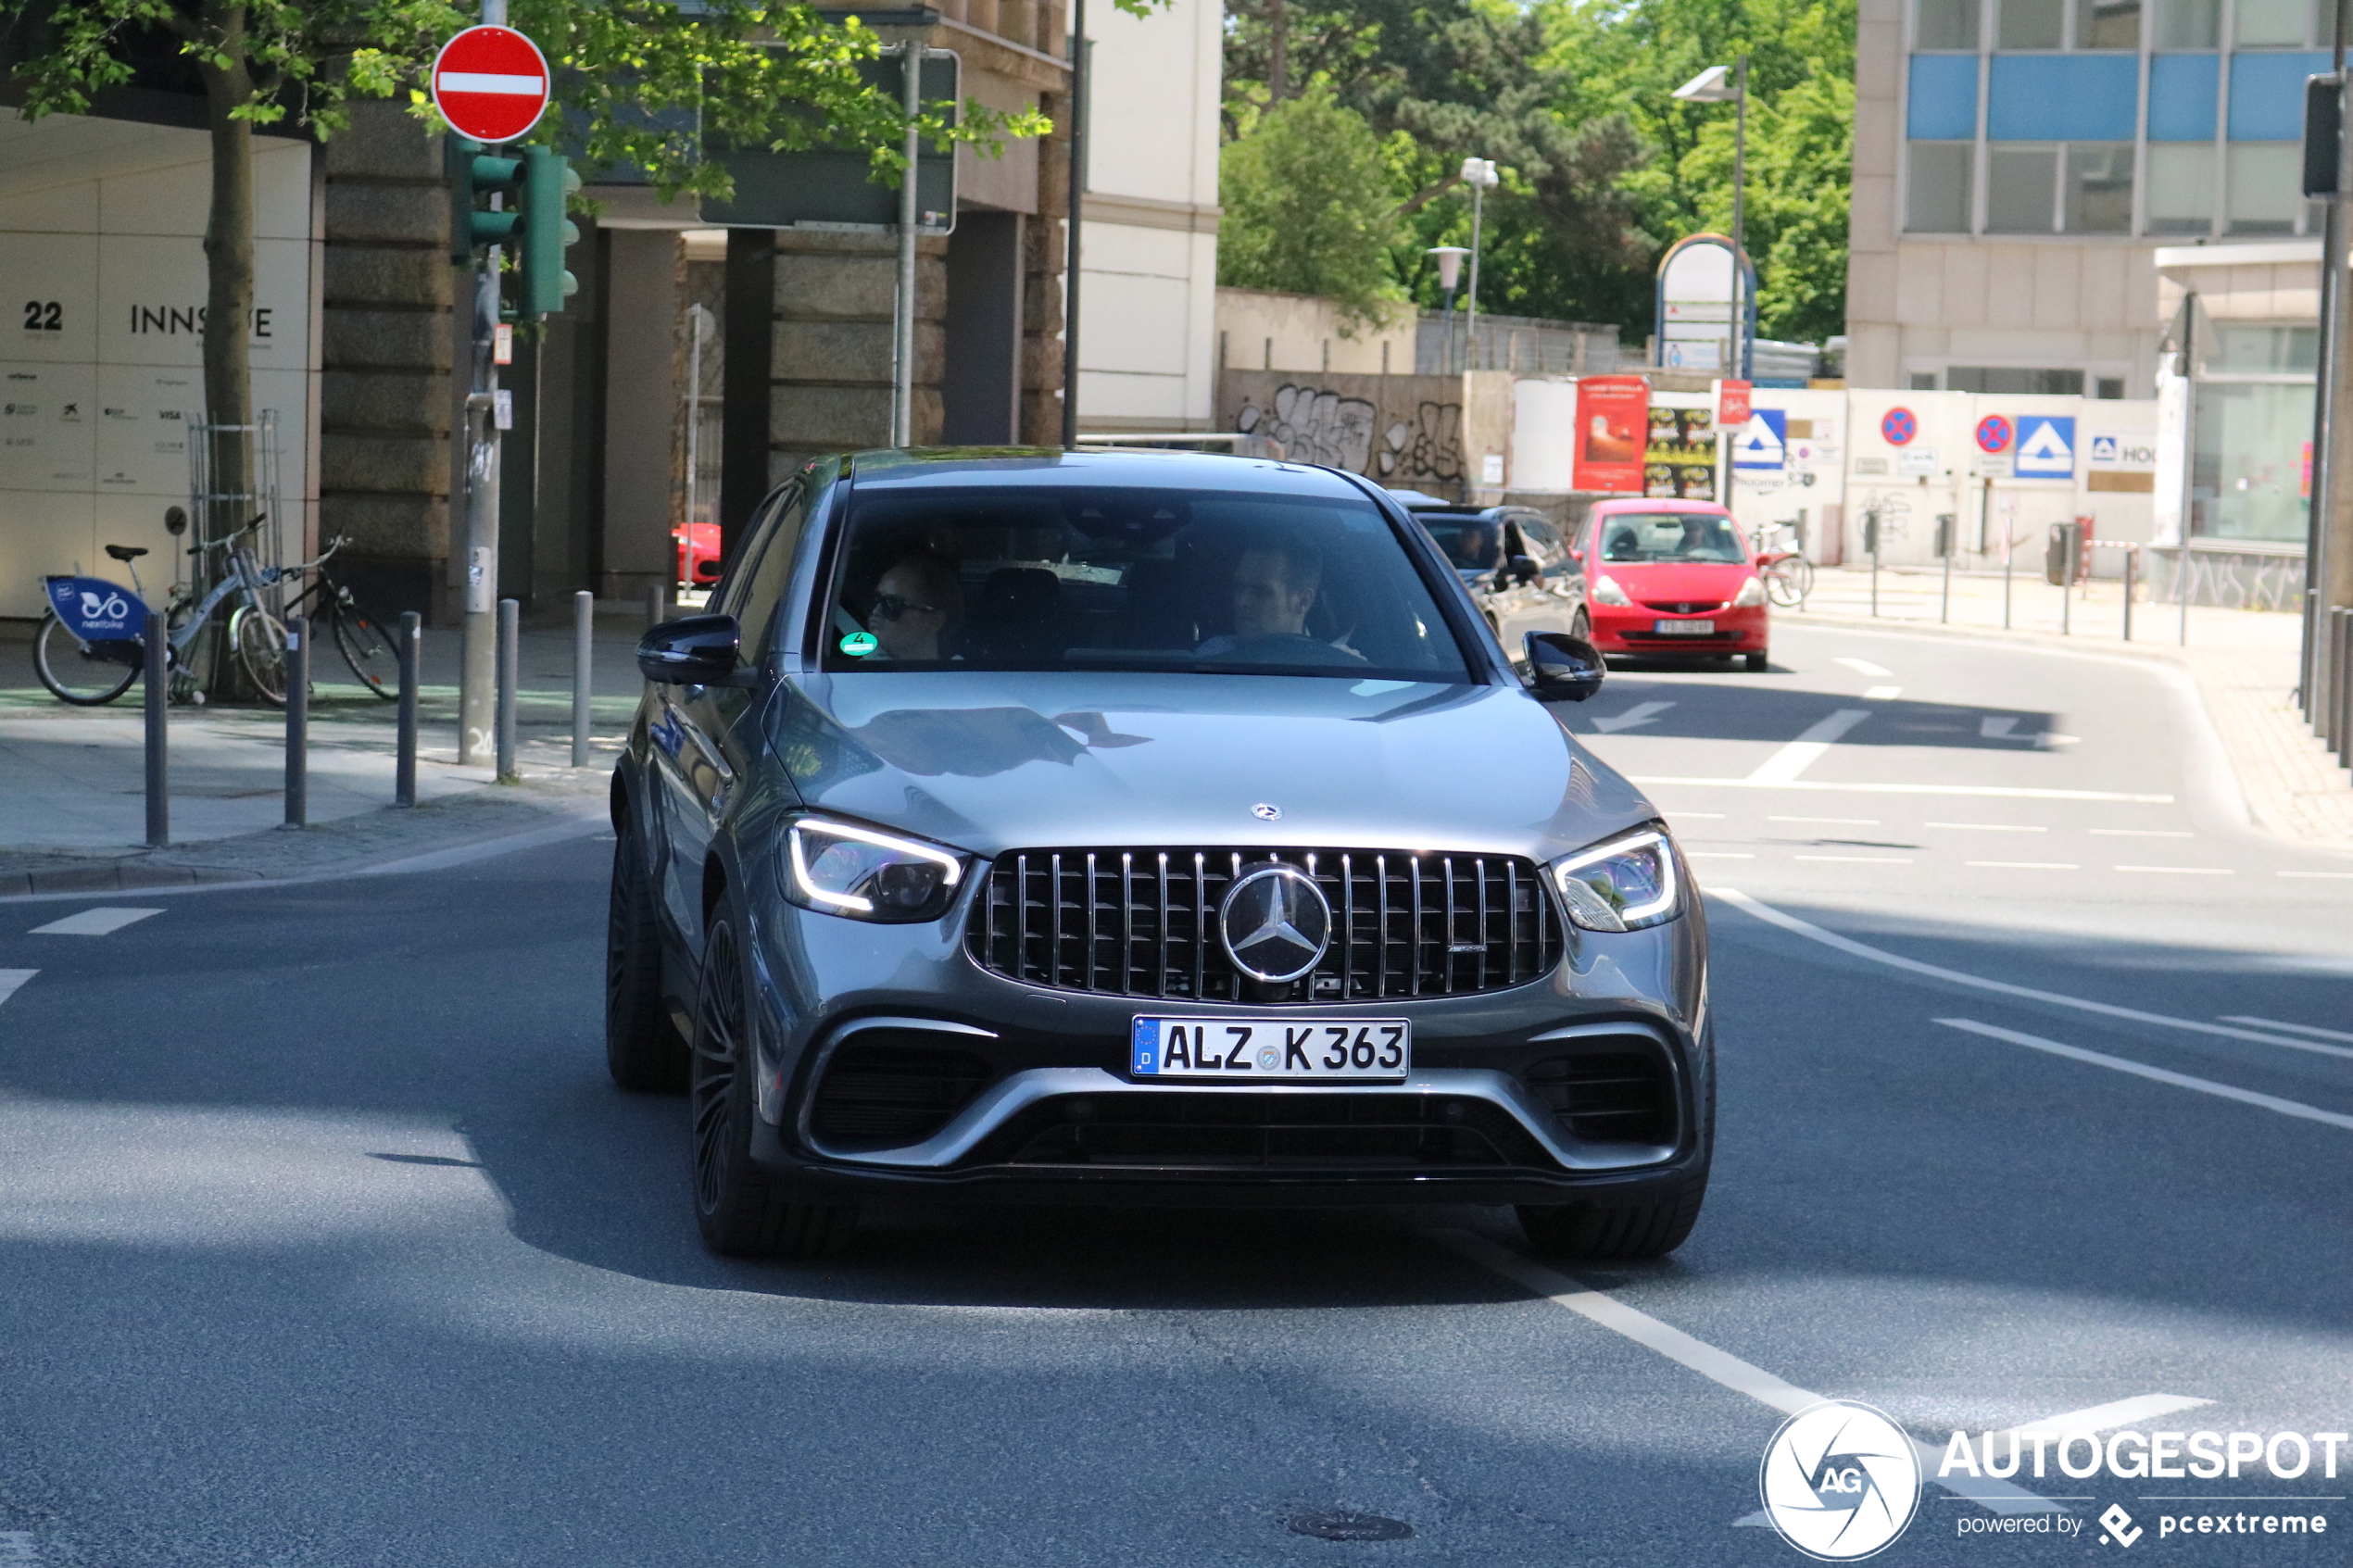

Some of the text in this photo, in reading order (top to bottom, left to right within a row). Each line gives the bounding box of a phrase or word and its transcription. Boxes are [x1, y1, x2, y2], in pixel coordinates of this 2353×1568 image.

[24, 301, 63, 331] 22
[159, 409, 182, 420] VISA
[82, 618, 124, 630] nextbike
[854, 633, 864, 643] 4
[1163, 1024, 1253, 1070] ALZ
[1285, 1027, 1314, 1070] K
[1323, 1026, 1403, 1070] 363
[1140, 1052, 1151, 1065] D
